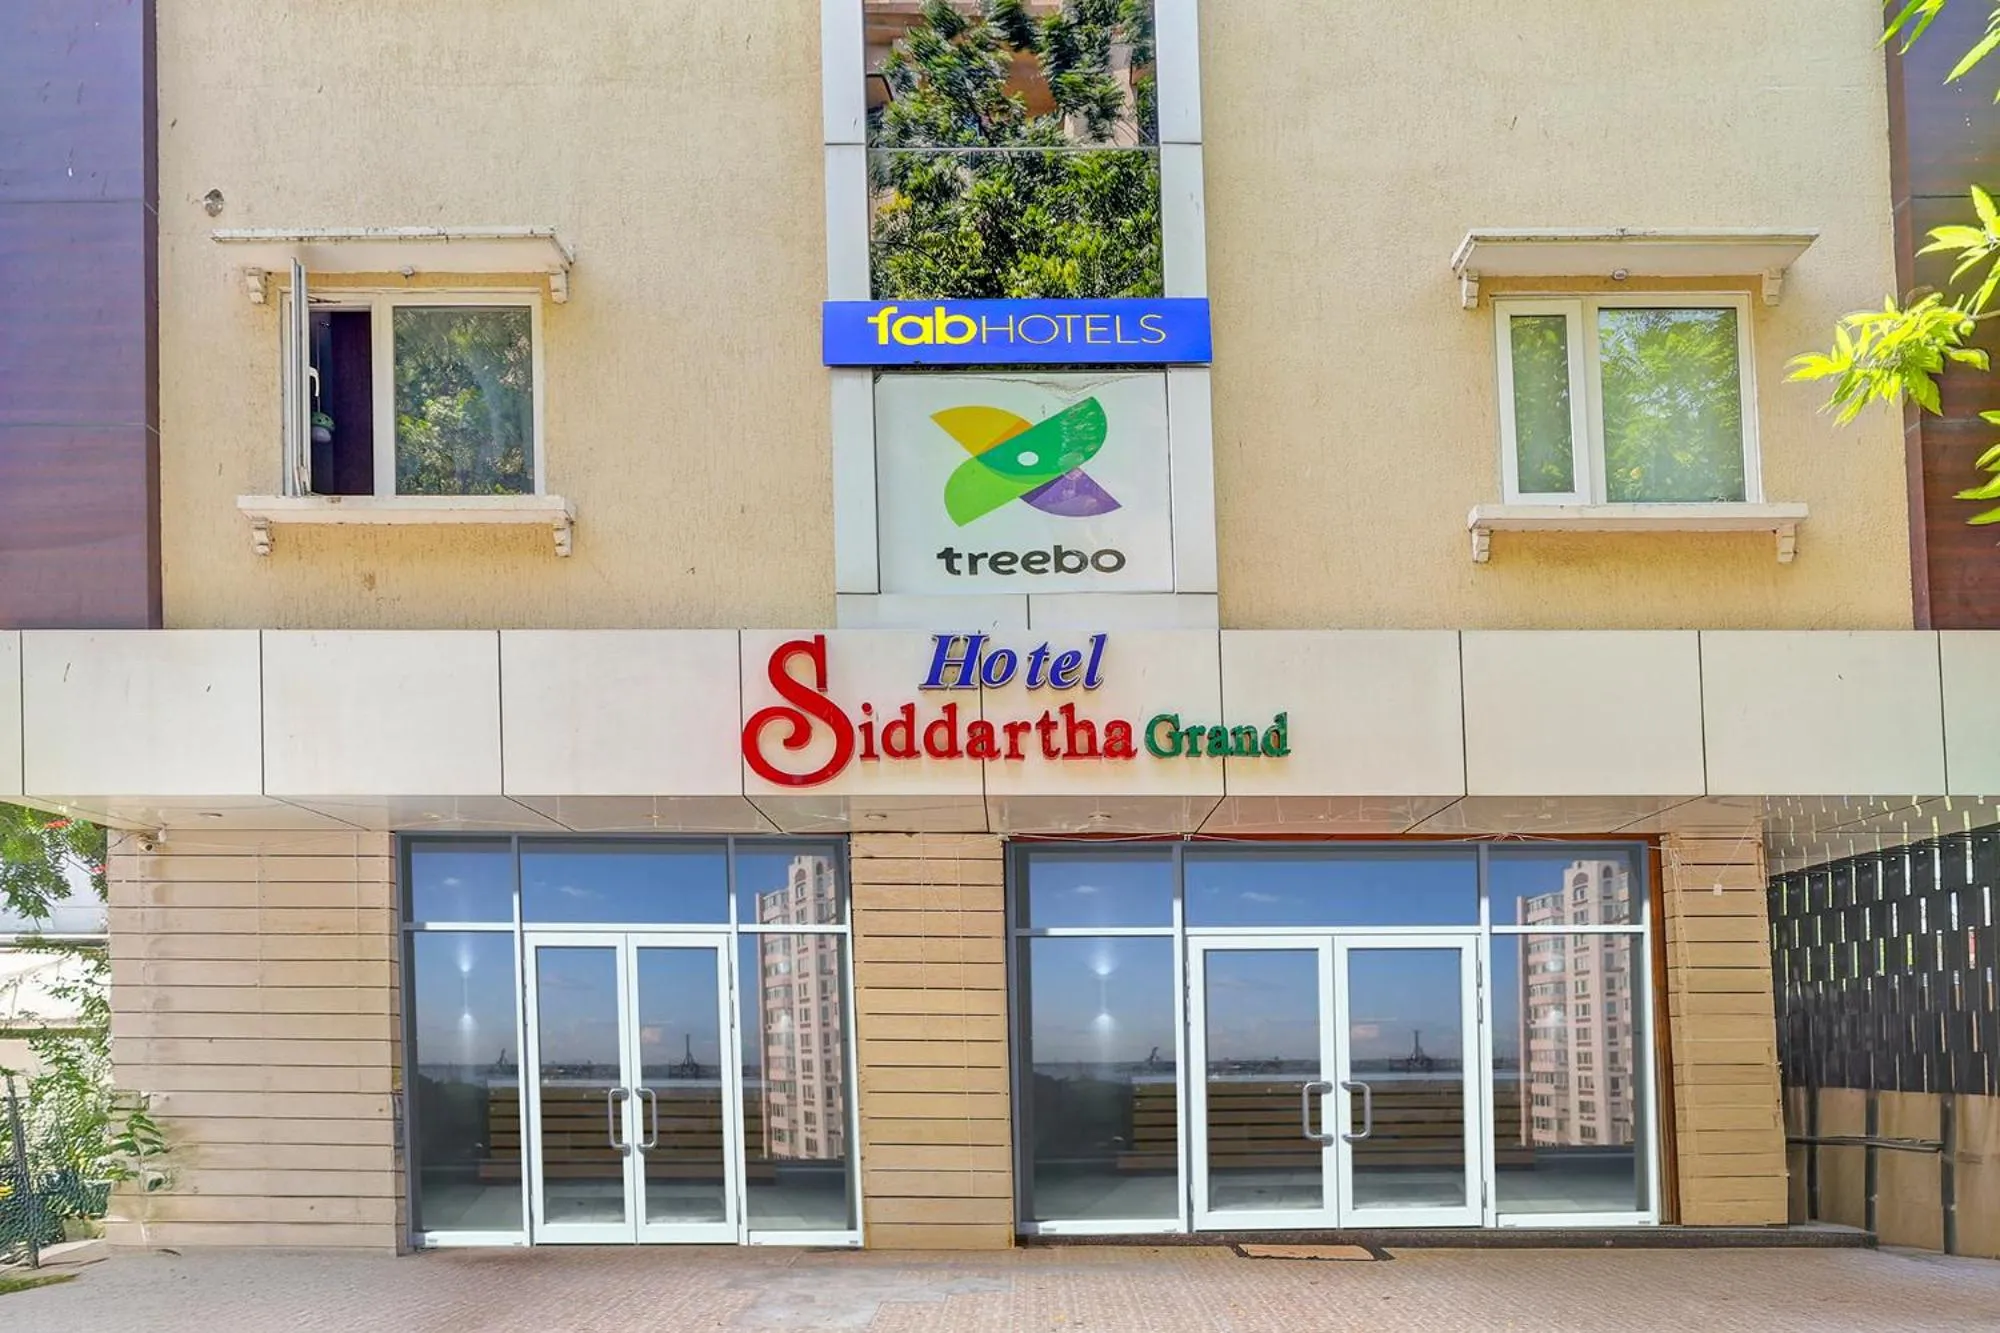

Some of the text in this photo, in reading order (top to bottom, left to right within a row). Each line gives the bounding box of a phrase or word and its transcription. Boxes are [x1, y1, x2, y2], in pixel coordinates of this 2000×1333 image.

[936, 544, 1126, 576] treebo
[918, 632, 1108, 691] Hotel
[742, 634, 1291, 788] Siddartha Grand
